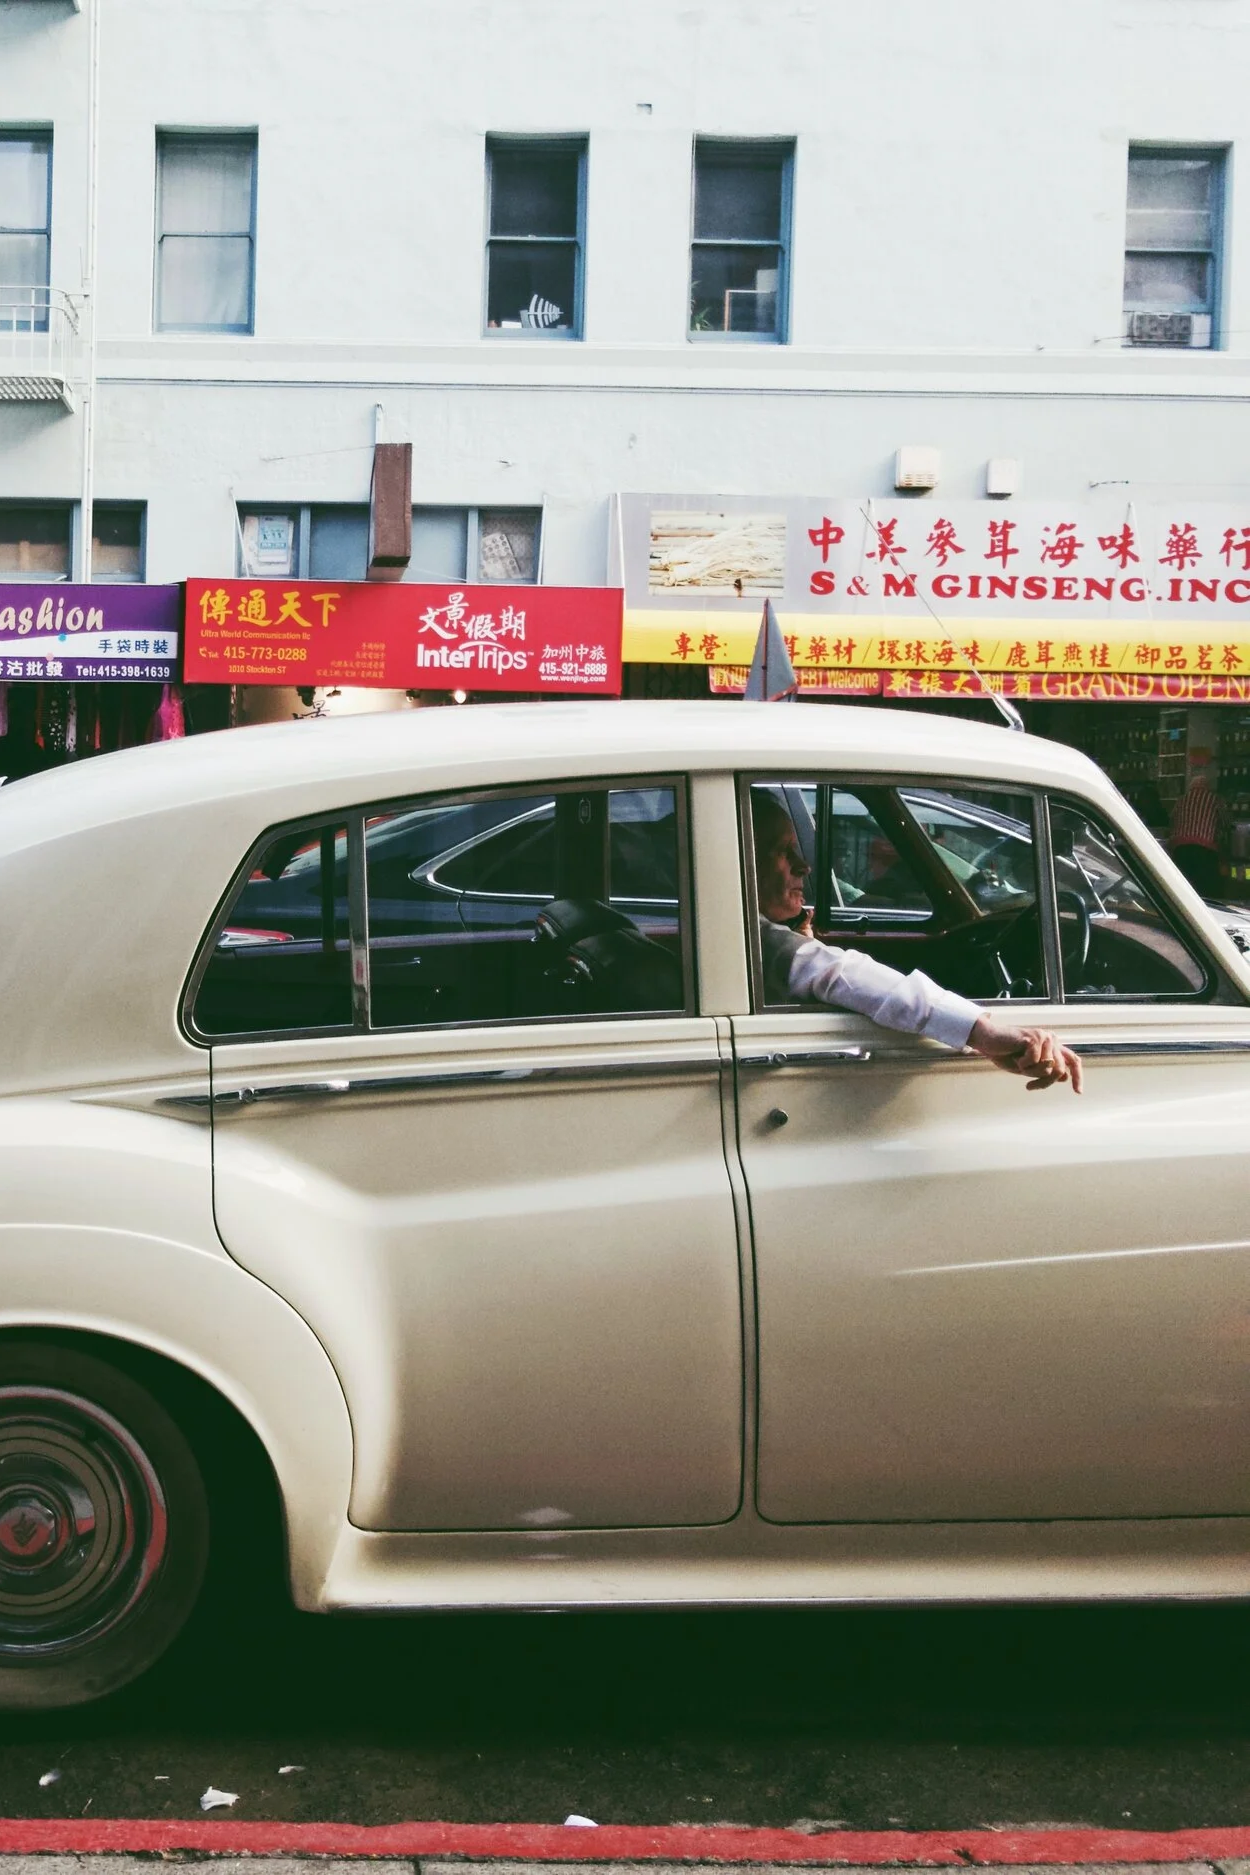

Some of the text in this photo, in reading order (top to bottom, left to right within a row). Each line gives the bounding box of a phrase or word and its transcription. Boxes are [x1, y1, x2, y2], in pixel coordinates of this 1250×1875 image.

[200, 587, 341, 628] 傳通天下
[200, 630, 219, 638] Ultra
[220, 630, 241, 638] World
[243, 630, 300, 640] Communication
[98, 639, 169, 654] 手袋時裝
[224, 646, 307, 661] 415-773-0288
[542, 644, 606, 662] 加州中旅
[228, 665, 245, 673] 1010
[246, 665, 276, 674] Stockton
[539, 662, 608, 676] 415-921-6888
[541, 675, 606, 683] www.wenjing.com
[827, 670, 879, 689] Welcome
[1041, 673, 1154, 699] GRAND
[1162, 675, 1250, 700] OPEN
